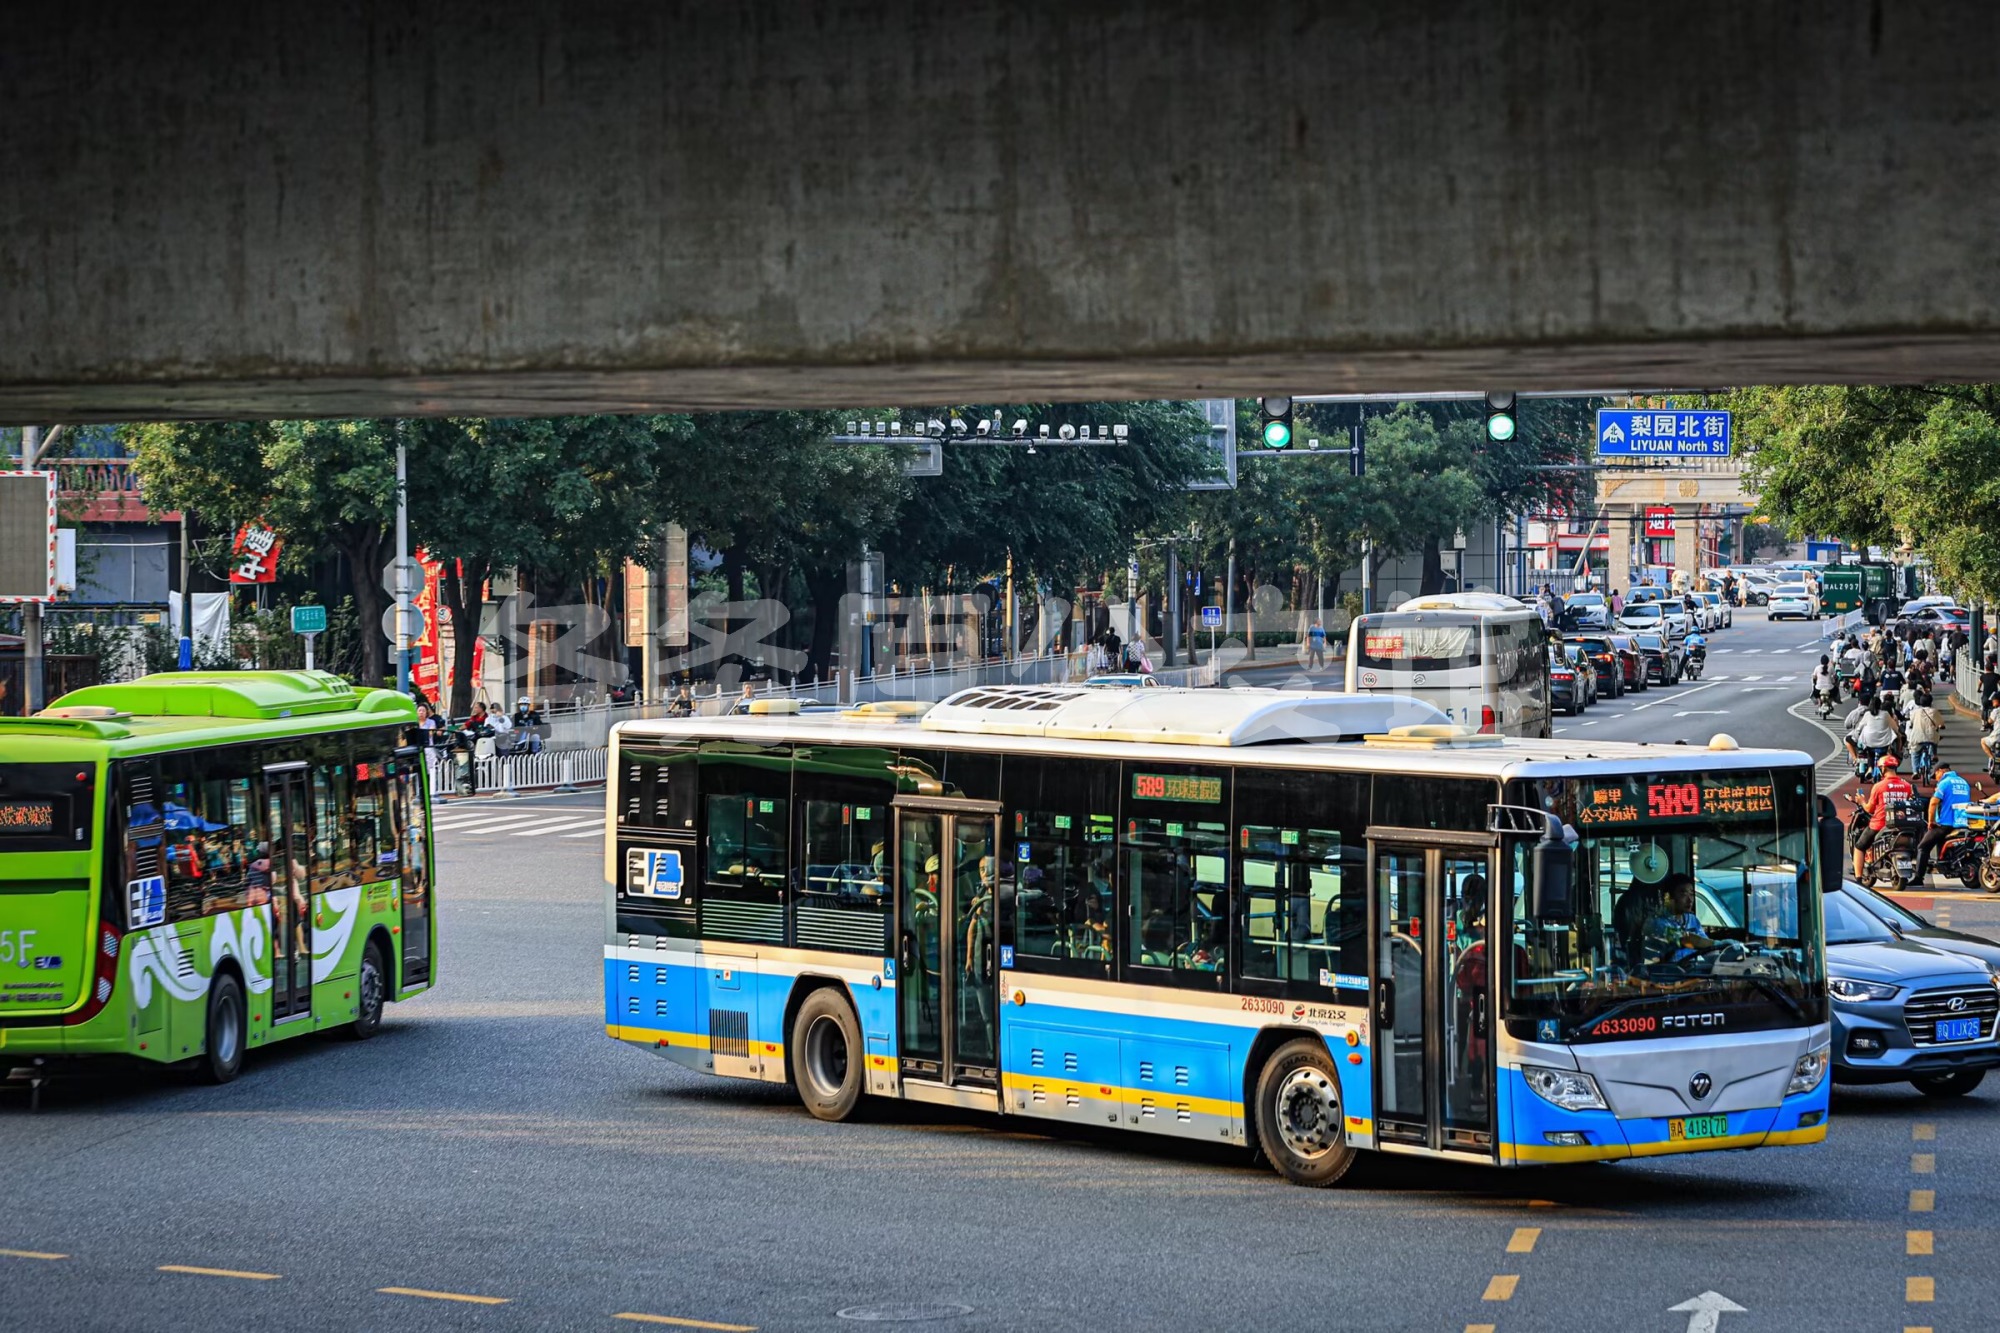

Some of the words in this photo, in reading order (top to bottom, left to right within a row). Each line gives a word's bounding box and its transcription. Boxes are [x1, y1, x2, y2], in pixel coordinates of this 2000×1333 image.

[1610, 426, 1618, 435] 北
[1631, 415, 1725, 438] 梨园北街
[1631, 439, 1672, 452] LIYUAN
[1678, 440, 1707, 452] North
[1713, 441, 1724, 452] St
[1137, 775, 1164, 797] 589
[1165, 779, 1221, 800] 环球度假区
[1647, 783, 1700, 817] 589
[0, 805, 53, 827] 铁潞城站
[1579, 805, 1638, 823] 公交场站
[1241, 996, 1285, 1015] 2633090
[1309, 1007, 1346, 1020] 北京公交
[1592, 1017, 1655, 1035] 2633090
[1662, 1012, 1725, 1029] FOTON
